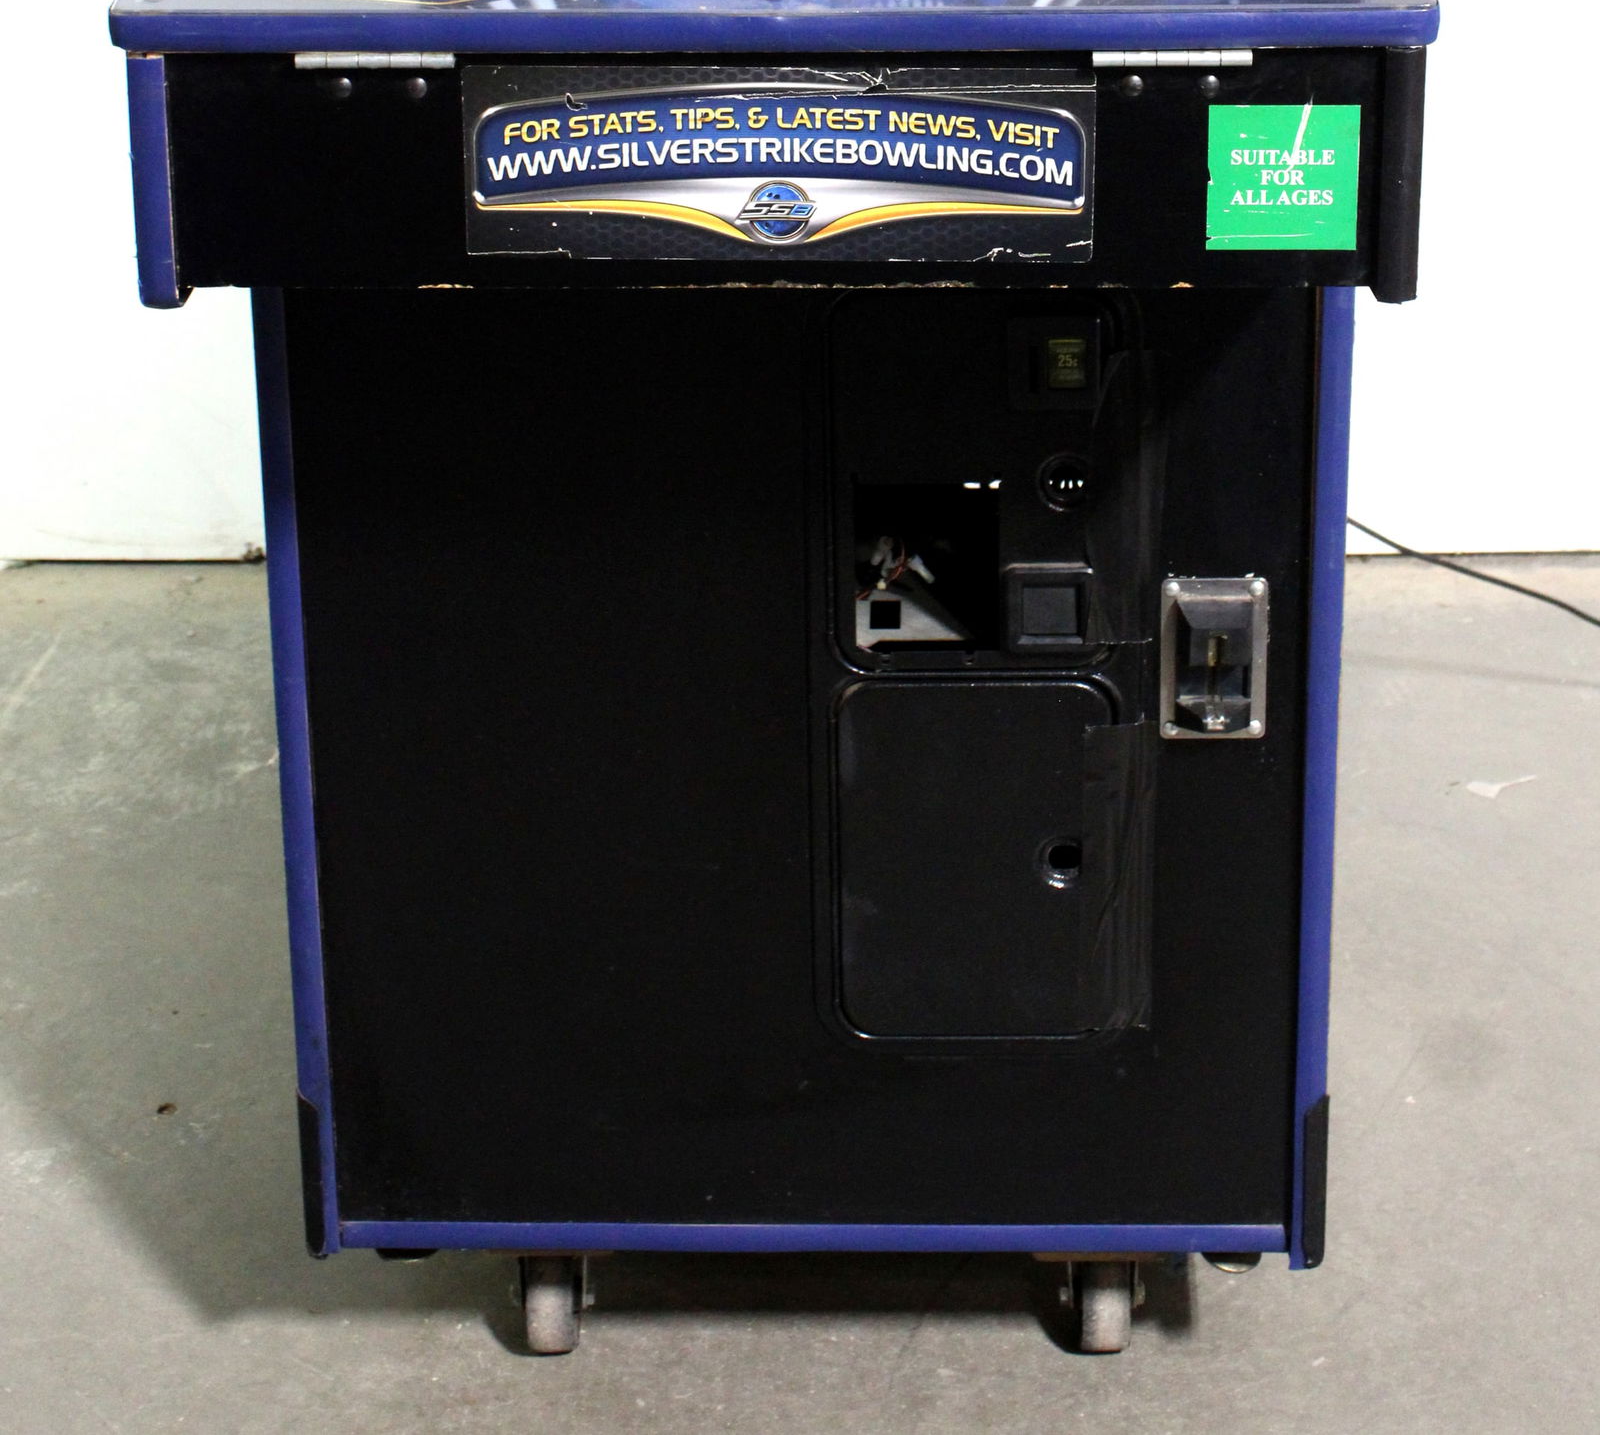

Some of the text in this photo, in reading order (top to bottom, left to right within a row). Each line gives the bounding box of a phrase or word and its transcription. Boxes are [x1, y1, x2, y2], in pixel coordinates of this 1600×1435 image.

[503, 107, 1061, 150] FOR STATS, TIPS, & LATEST NEWS, VISIT
[486, 137, 1075, 187] WWW.SILVERSTRIKEBOWLING.COM
[1230, 149, 1336, 166] SUITABLE
[1260, 169, 1305, 185] FOR
[1229, 190, 1334, 206] ALL AGES
